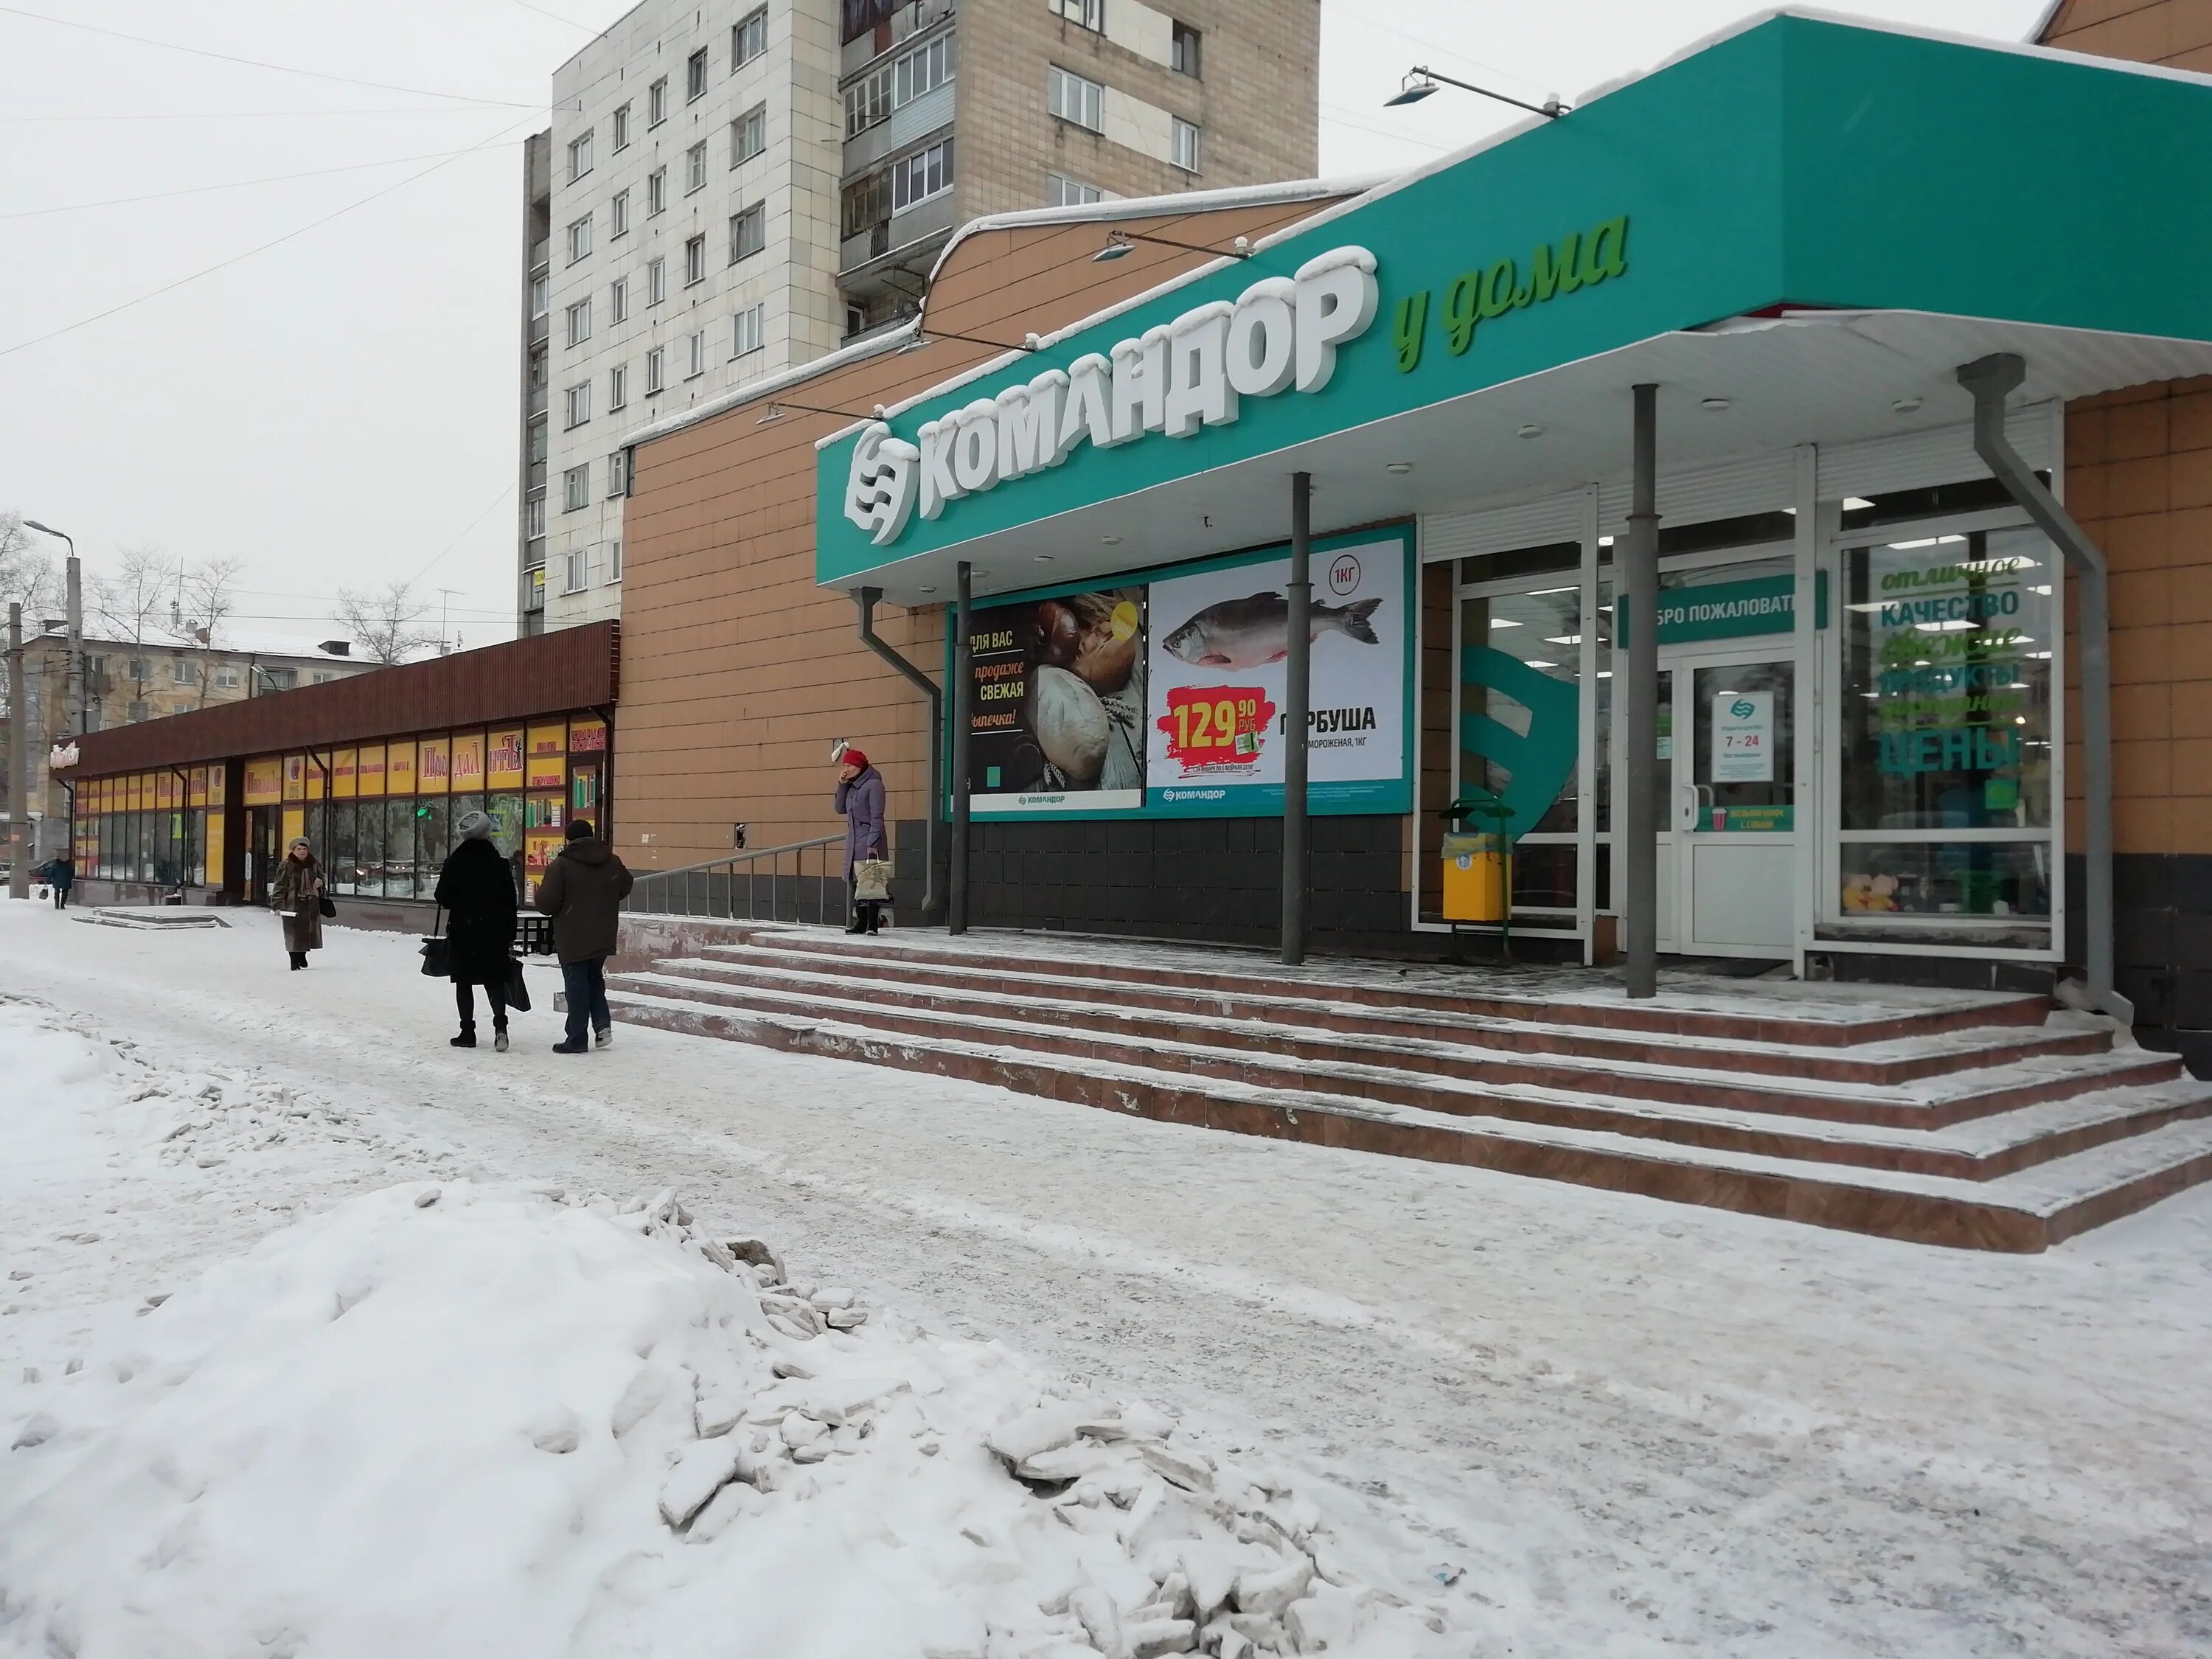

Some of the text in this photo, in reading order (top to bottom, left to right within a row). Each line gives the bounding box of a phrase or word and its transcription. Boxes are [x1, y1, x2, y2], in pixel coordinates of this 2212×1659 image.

[917, 217, 1627, 521] КОМАНДОР у дома
[1335, 566, 1355, 583] 1КГ
[1882, 557, 2020, 591] отличное
[1658, 607, 1684, 625] БРО
[1882, 591, 2019, 627] КАЧЕСТВО
[992, 630, 1013, 647] ВАС
[975, 661, 1024, 682] продаже
[981, 681, 1024, 700] СВЕЖАЯ
[1173, 700, 1236, 748] 129
[1238, 698, 1256, 717] 90
[1239, 718, 1256, 731] РУБ
[1280, 706, 1376, 735] ГРБУША
[1308, 738, 1354, 748] МОРОЖЕНАЯ,
[1726, 737, 1733, 747] 7
[1745, 735, 1759, 746] 24
[1880, 726, 2020, 779] ЦЕНЫ
[1027, 795, 1065, 804] КОМАНДОР
[1175, 790, 1225, 800] КОМАНДОР
